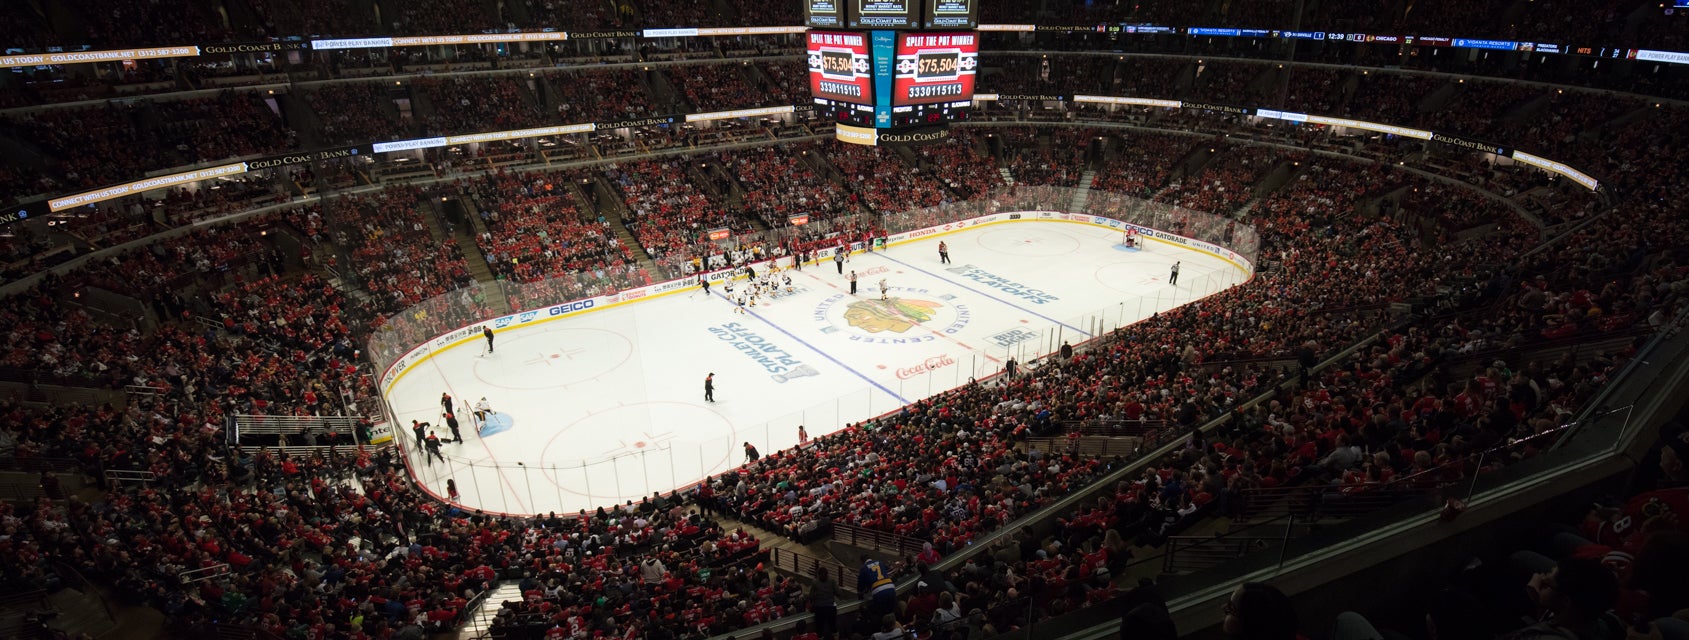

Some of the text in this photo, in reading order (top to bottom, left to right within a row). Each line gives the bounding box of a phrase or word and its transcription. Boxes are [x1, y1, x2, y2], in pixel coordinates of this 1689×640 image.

[811, 34, 863, 46] SPLIT THE POT WINNER
[906, 36, 974, 47] SPLIT THE POT WINNER
[51, 52, 135, 62] GOLDCOASTBANK.NET
[157, 48, 189, 56] 587-3200
[823, 55, 852, 72] $75,504
[919, 58, 957, 74] $75,504
[820, 82, 861, 96] 3330115113
[909, 84, 962, 98] 3330115113
[621, 120, 646, 129] COAST
[881, 133, 910, 142] GOLD
[913, 132, 939, 141] COAST
[1434, 134, 1497, 153] GOLD COAST BANK
[250, 150, 349, 170] GOLD COAS BANK
[52, 197, 83, 208] CONNECT
[84, 192, 100, 201] WITH
[109, 186, 129, 196] TODAY
[132, 172, 198, 191] GOLDCOASTBANK.NET
[909, 228, 936, 238] HONDA
[1156, 232, 1187, 244] GATORADE
[1192, 242, 1214, 251] UNITED
[962, 274, 1049, 304] PLAYOFFS
[969, 269, 1059, 300] STANLEY CUP
[549, 299, 594, 316] GEICO
[815, 294, 845, 321] UNITED
[495, 317, 512, 328] SAP
[520, 312, 536, 323] SAP
[946, 304, 970, 334] UNITED
[849, 334, 935, 344] CENTER
[993, 329, 1023, 341] BUD
[998, 332, 1038, 347] LIGHT
[708, 327, 788, 373] STANLEY CUP
[722, 322, 801, 366] PLAYOFFS
[896, 353, 955, 380] Coca-Cola
